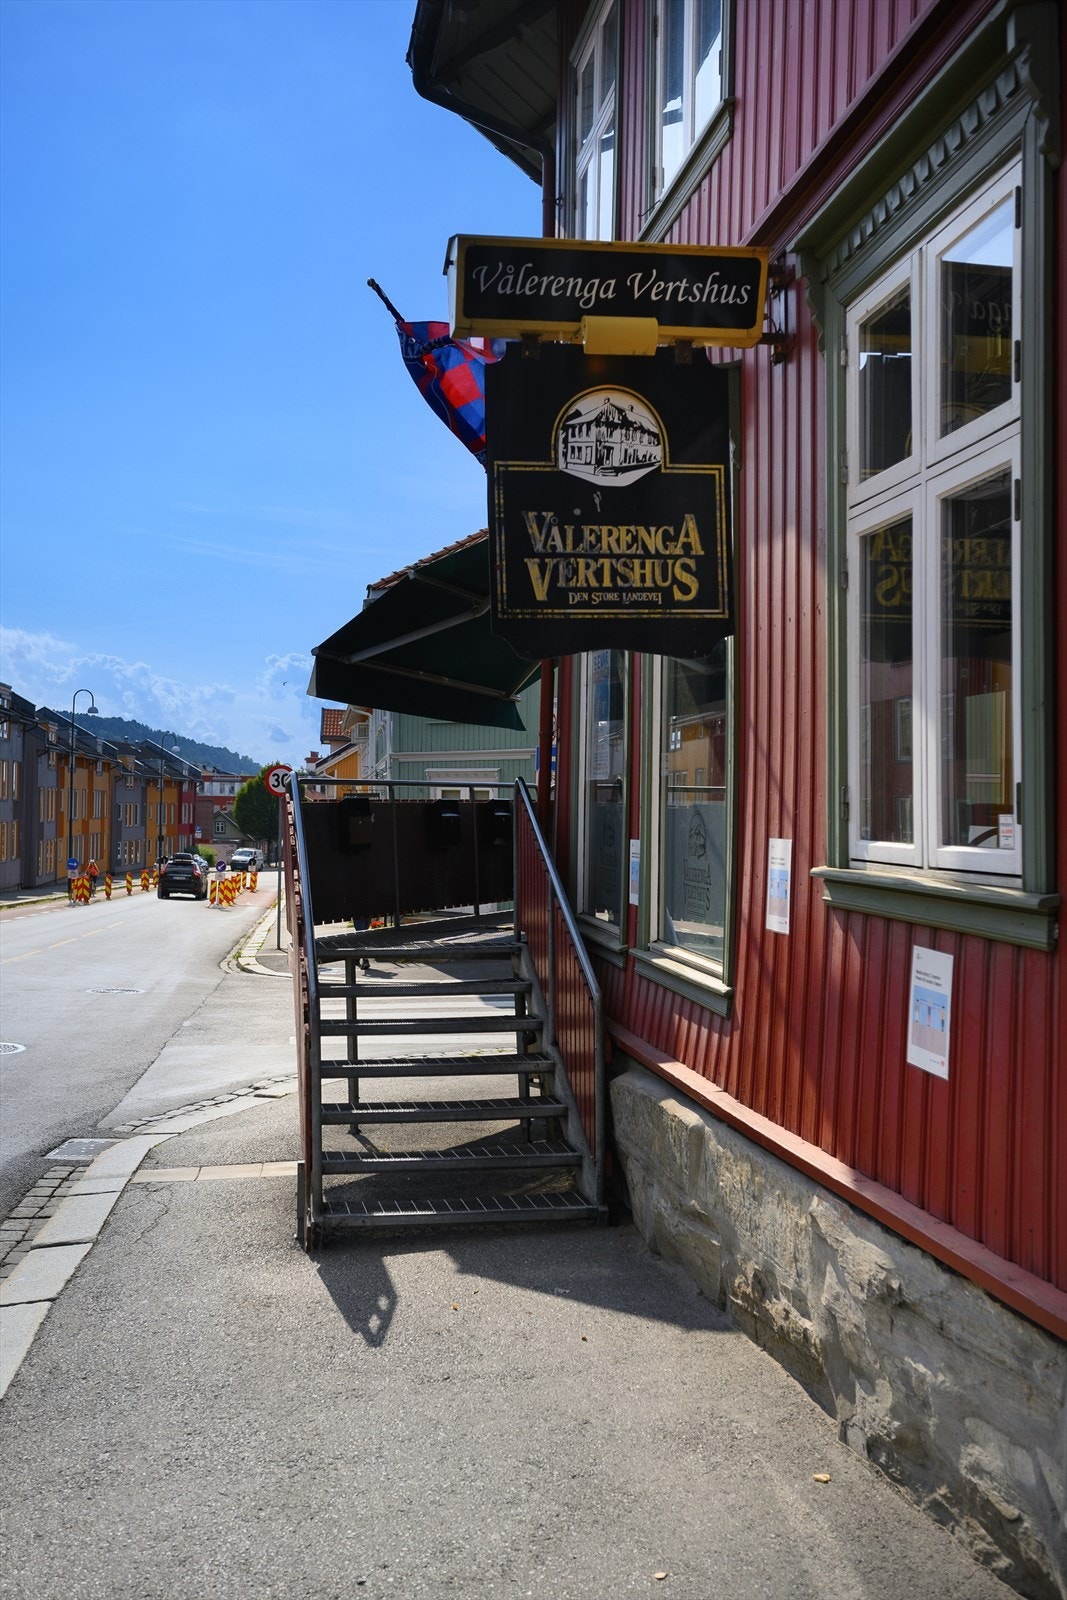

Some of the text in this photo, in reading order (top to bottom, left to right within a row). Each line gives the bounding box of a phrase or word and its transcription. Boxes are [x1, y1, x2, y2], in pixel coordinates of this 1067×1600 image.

[472, 262, 751, 309] Vålerenga Vertshus
[521, 511, 704, 555] VÅLERENGA
[524, 557, 699, 601] VERTSHUS
[591, 592, 619, 604] STORE
